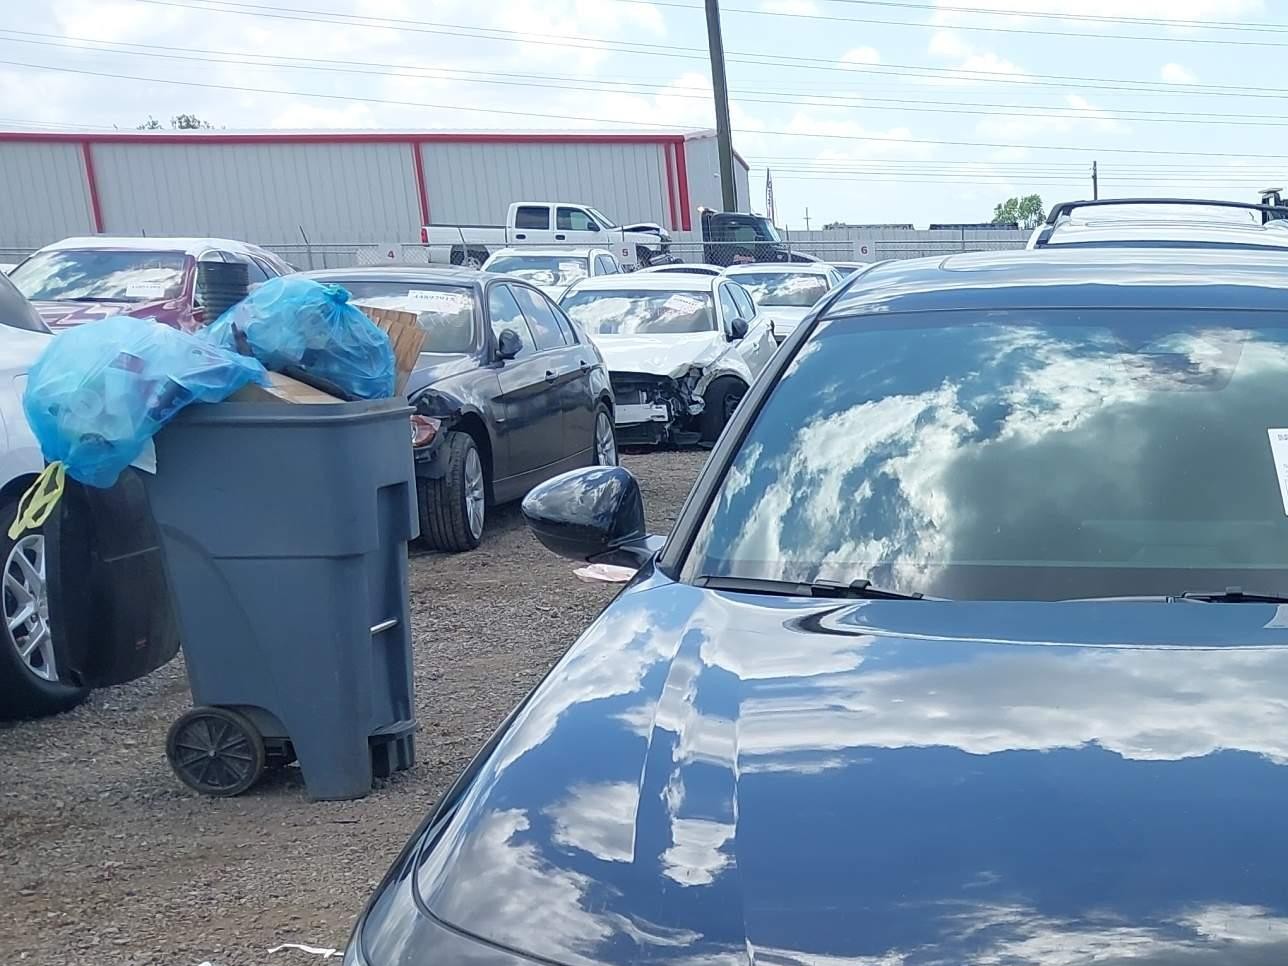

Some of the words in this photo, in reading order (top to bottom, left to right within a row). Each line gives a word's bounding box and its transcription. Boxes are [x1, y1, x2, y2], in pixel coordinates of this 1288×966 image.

[387, 250, 395, 259] 4
[622, 248, 629, 257] 5
[860, 246, 868, 255] 6
